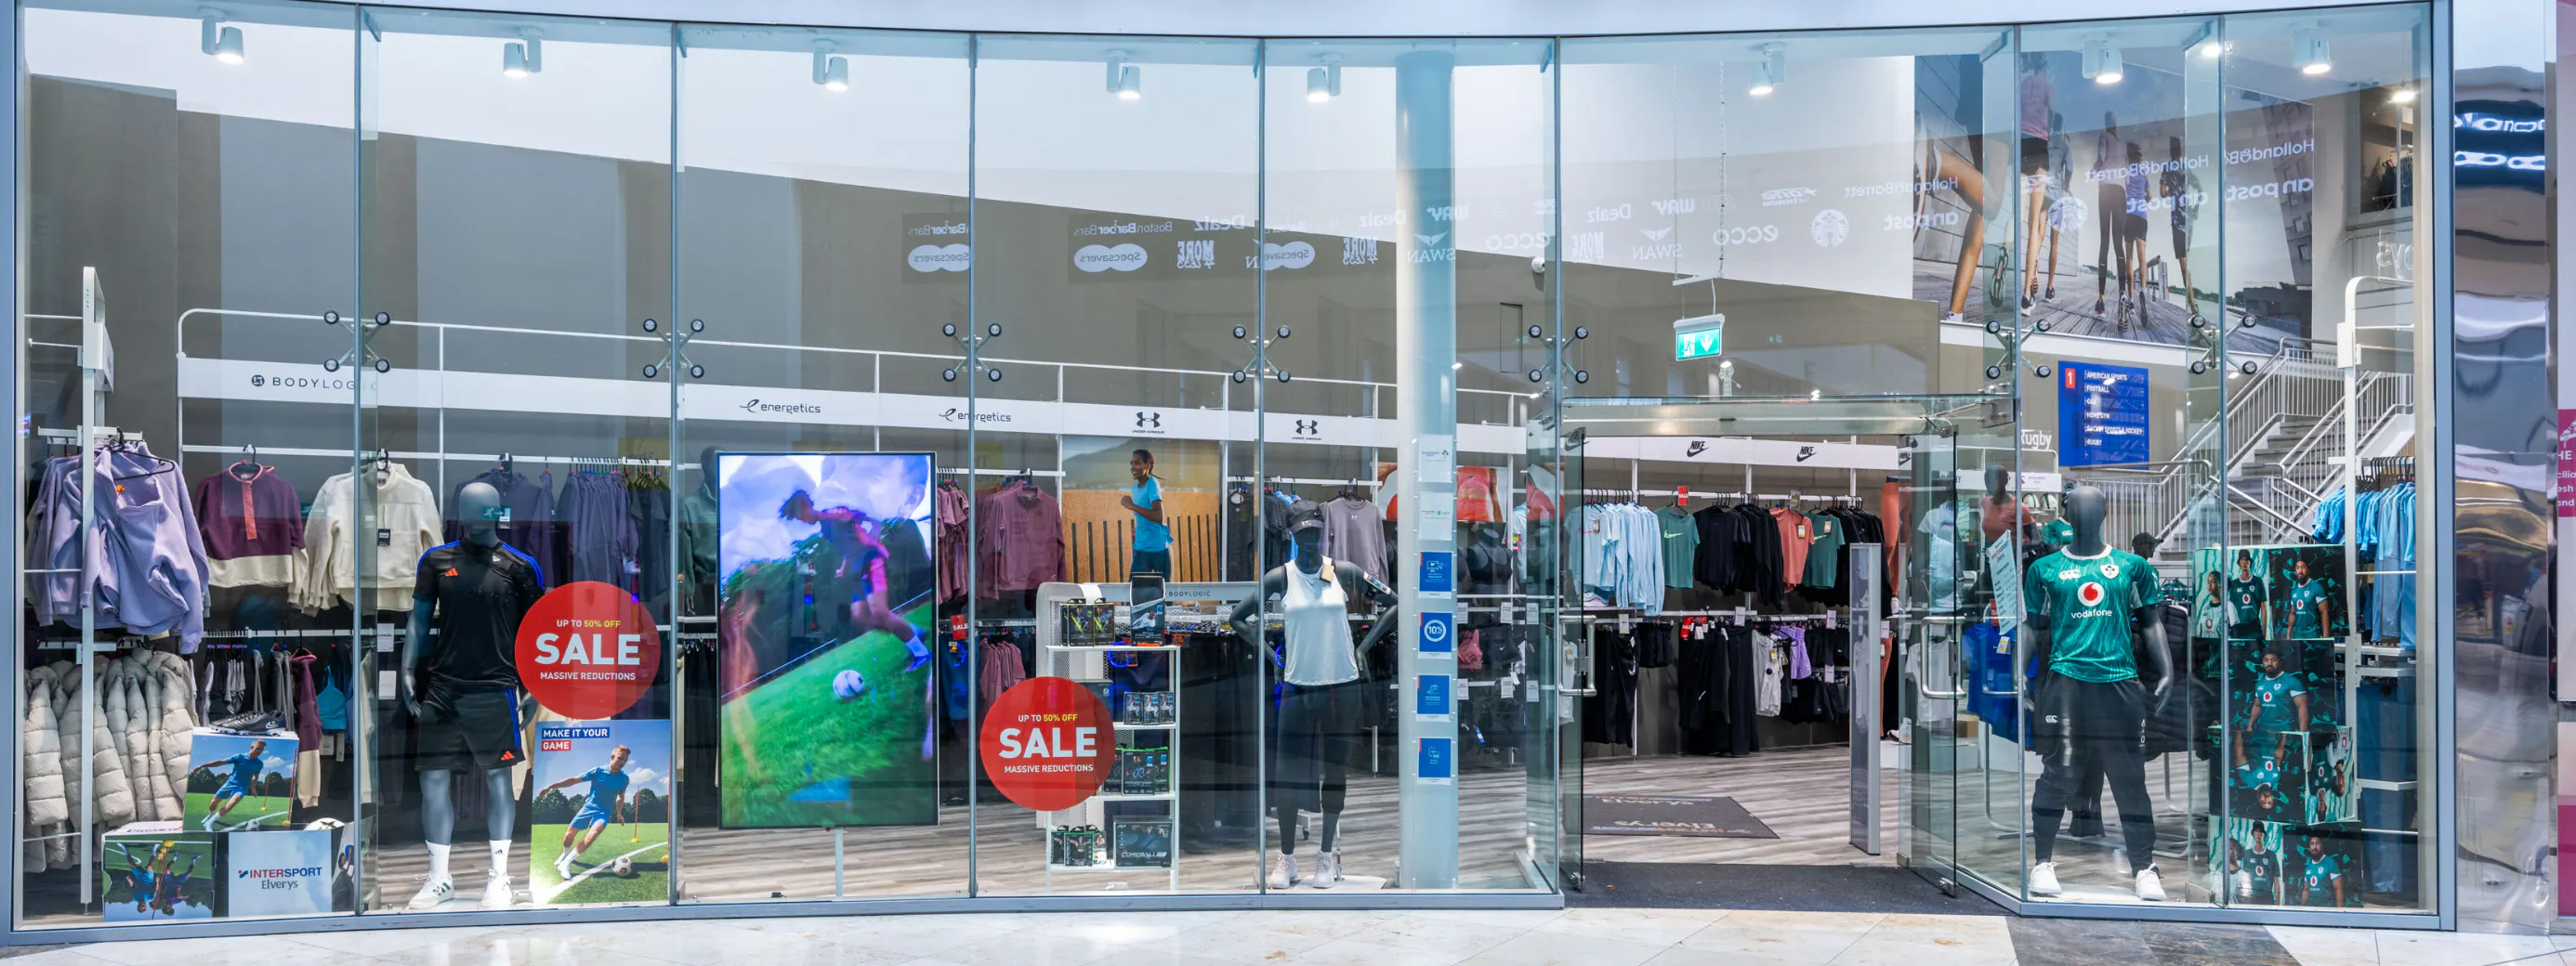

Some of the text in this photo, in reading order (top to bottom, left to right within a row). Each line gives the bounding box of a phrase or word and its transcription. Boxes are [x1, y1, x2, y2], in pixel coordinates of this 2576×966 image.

[2068, 372, 2072, 385] 1
[761, 403, 821, 415] energetics
[958, 412, 1011, 423] enrgetics
[1690, 440, 1705, 450] NIKE
[1800, 447, 1814, 455] NIKE
[2070, 608, 2112, 619] vodafone
[534, 633, 640, 665] SALE
[544, 729, 570, 738] MAKE
[999, 727, 1097, 758] SALE
[250, 868, 322, 879] INTERSPORT
[262, 880, 298, 890] Elverys
